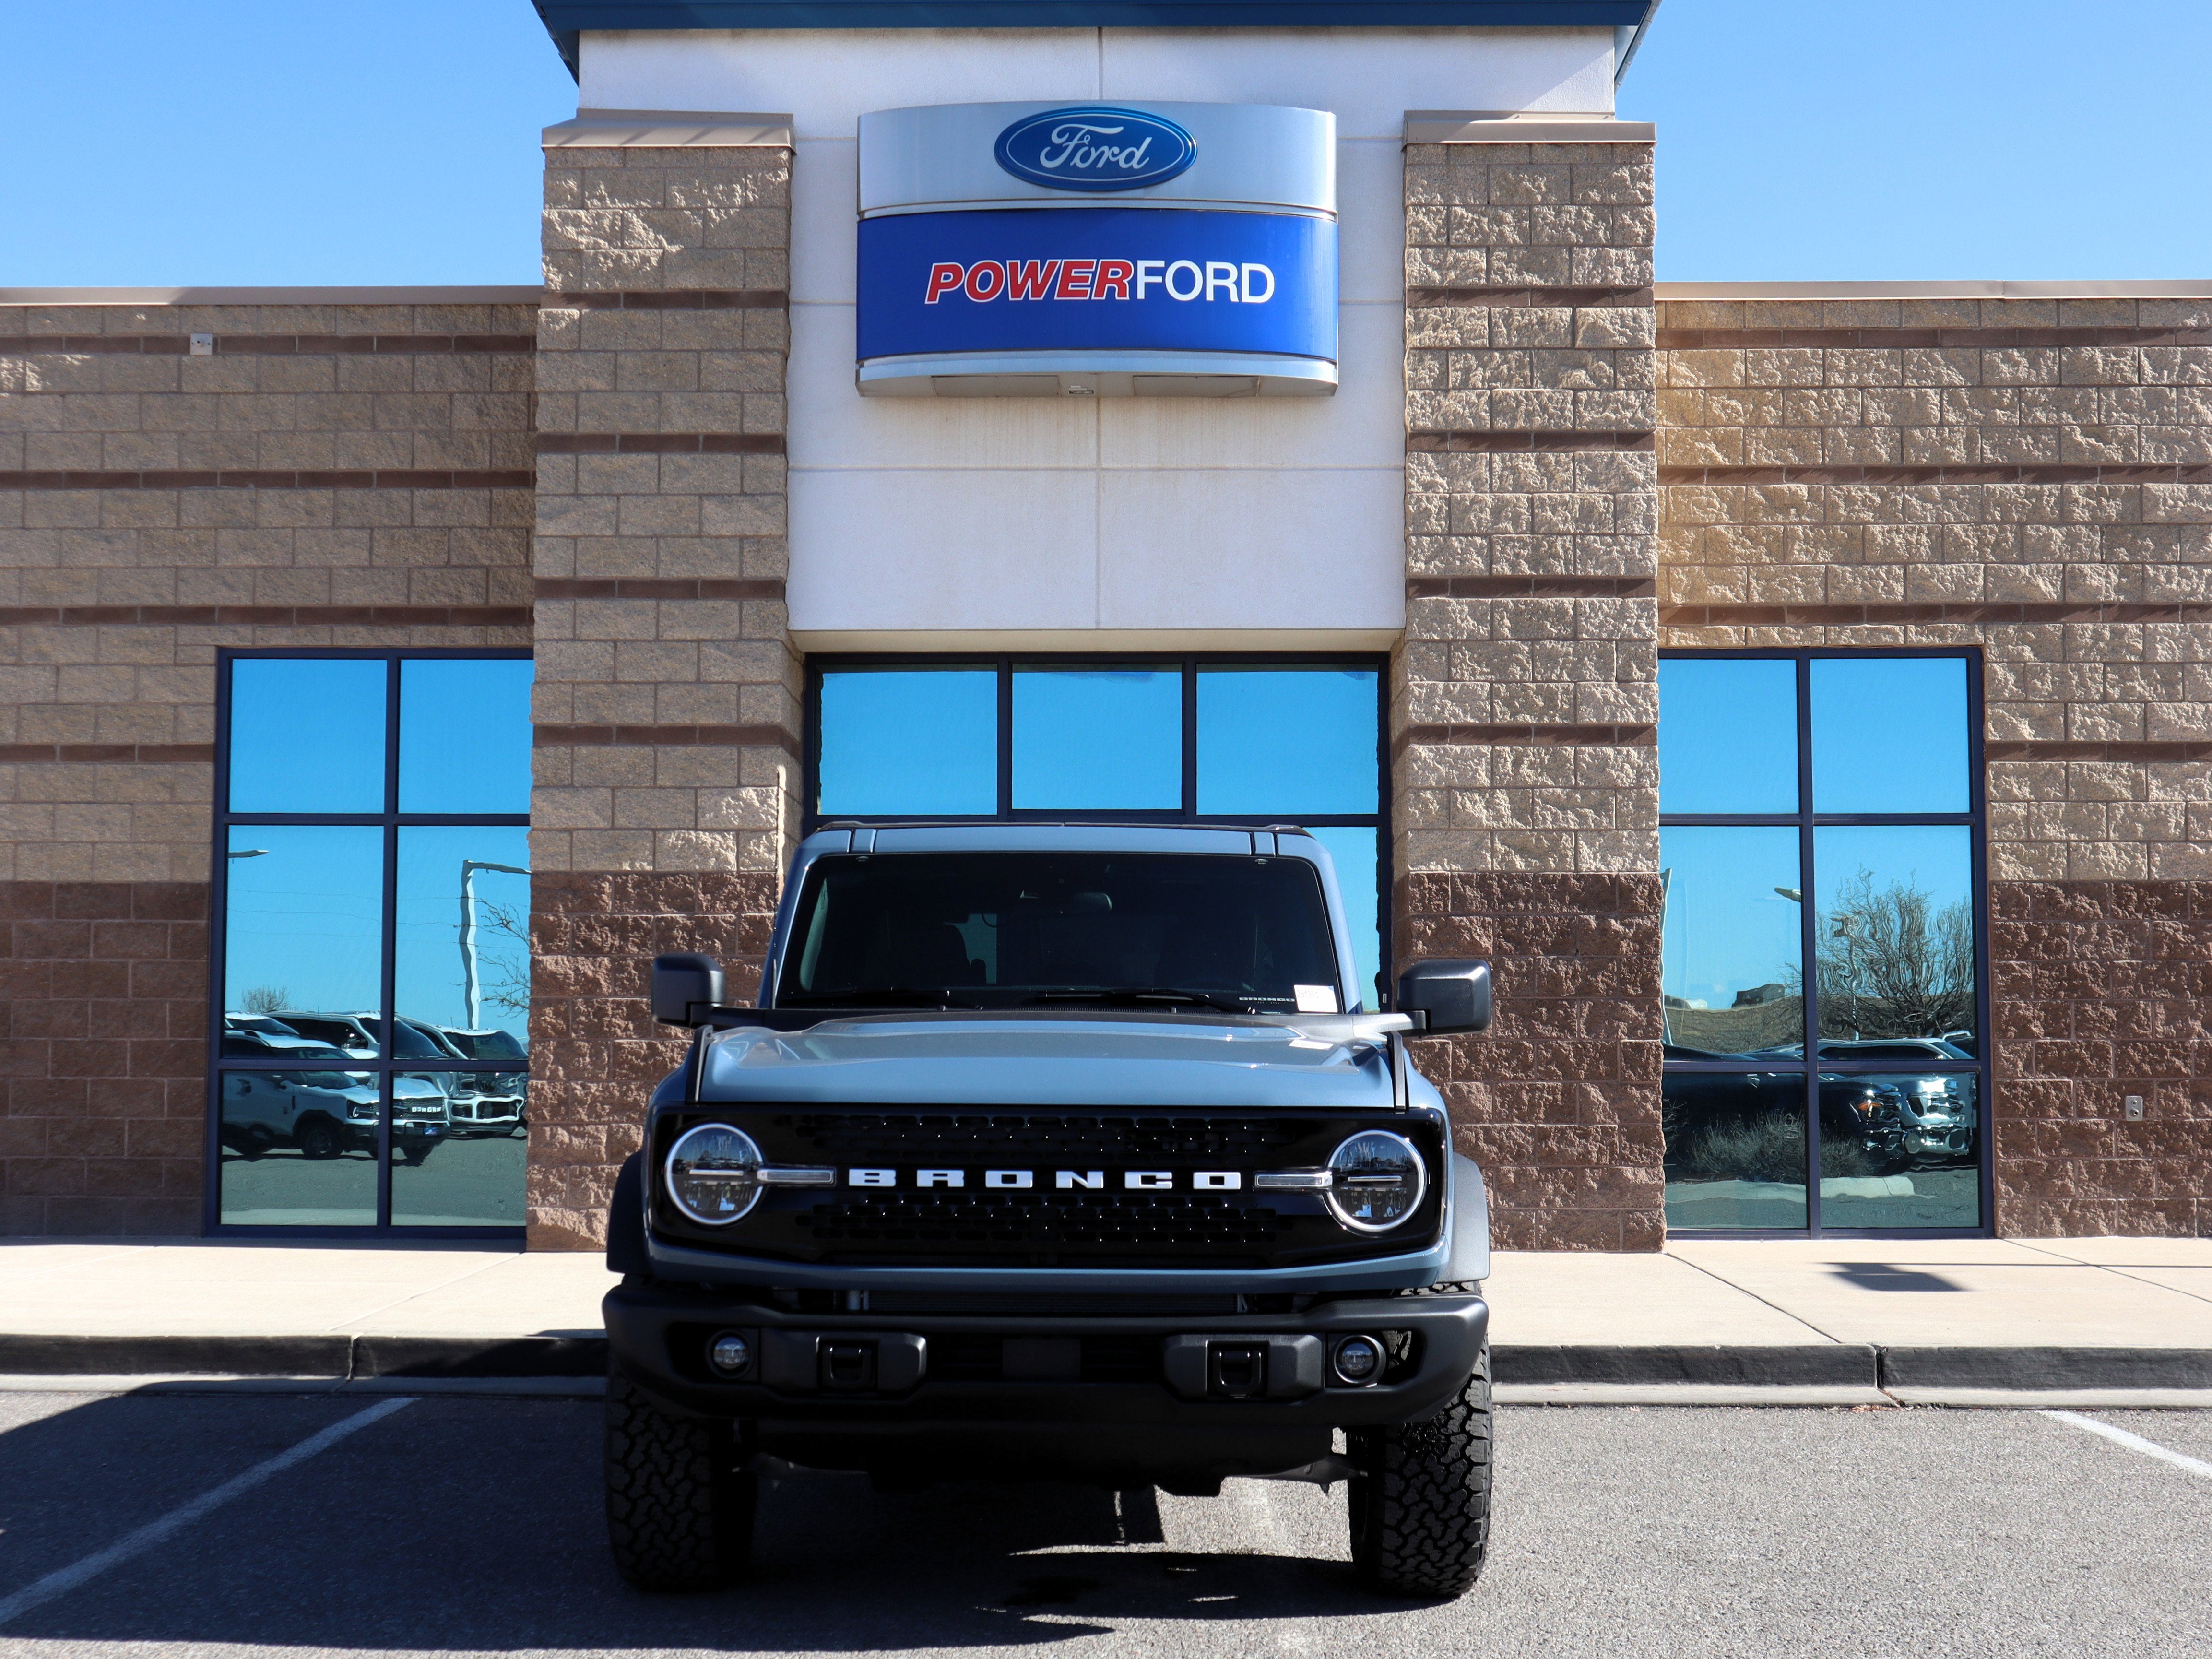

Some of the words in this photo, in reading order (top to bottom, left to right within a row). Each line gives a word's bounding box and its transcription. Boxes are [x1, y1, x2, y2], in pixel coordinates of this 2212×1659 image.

[1040, 123, 1152, 169] Ford
[924, 259, 1276, 304] POWERFORD
[849, 1168, 1242, 1190] BRONCO
